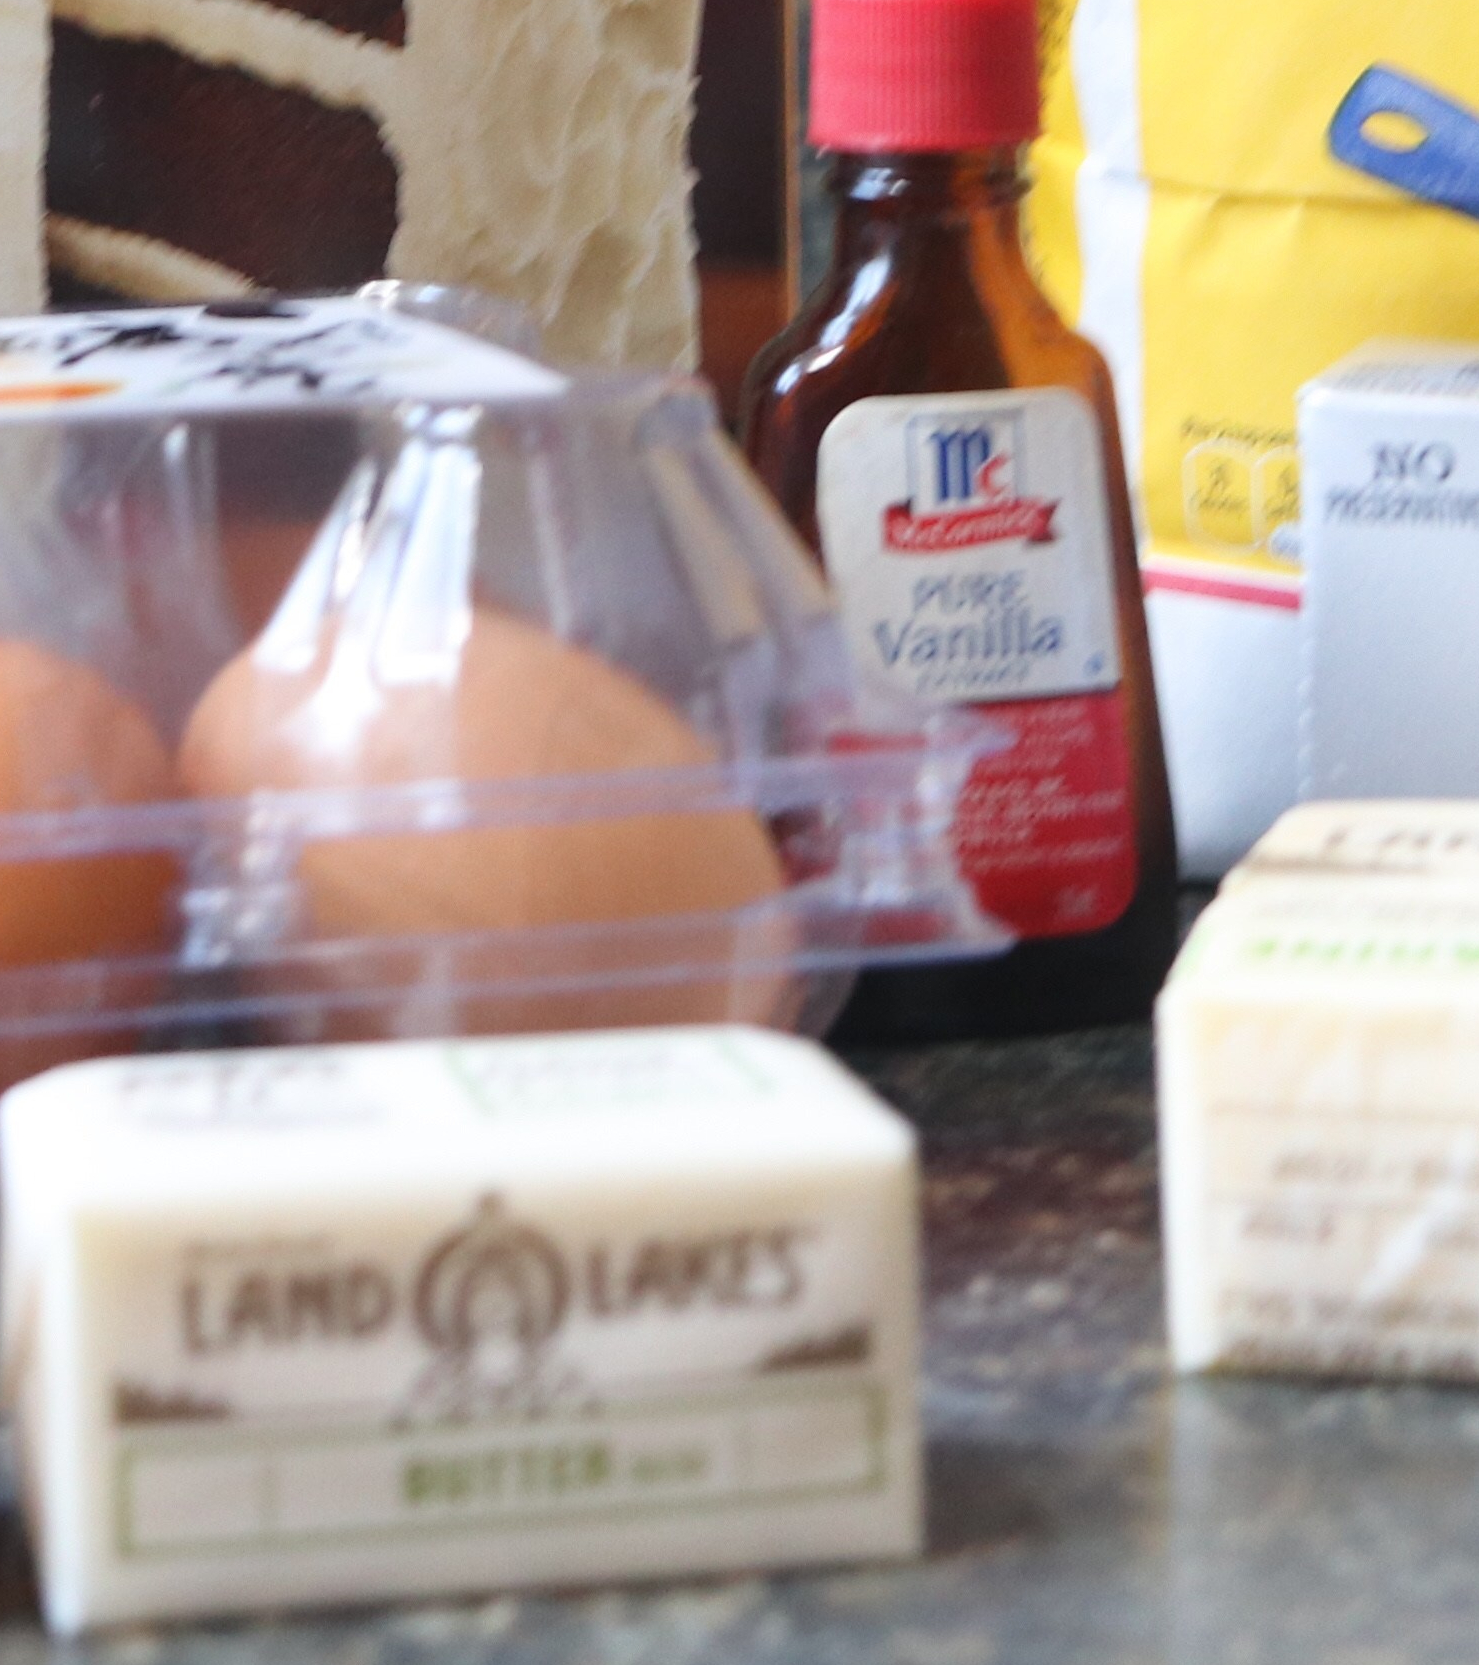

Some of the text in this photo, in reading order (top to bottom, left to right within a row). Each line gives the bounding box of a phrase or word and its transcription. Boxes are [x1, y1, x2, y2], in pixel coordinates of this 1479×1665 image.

[1370, 440, 1457, 484] NO
[911, 568, 1028, 610] PURE
[871, 612, 1065, 667] Vanilla
[176, 1261, 398, 1356] LAND
[584, 1222, 818, 1321] LAKES
[397, 1438, 616, 1507] BUTTER
